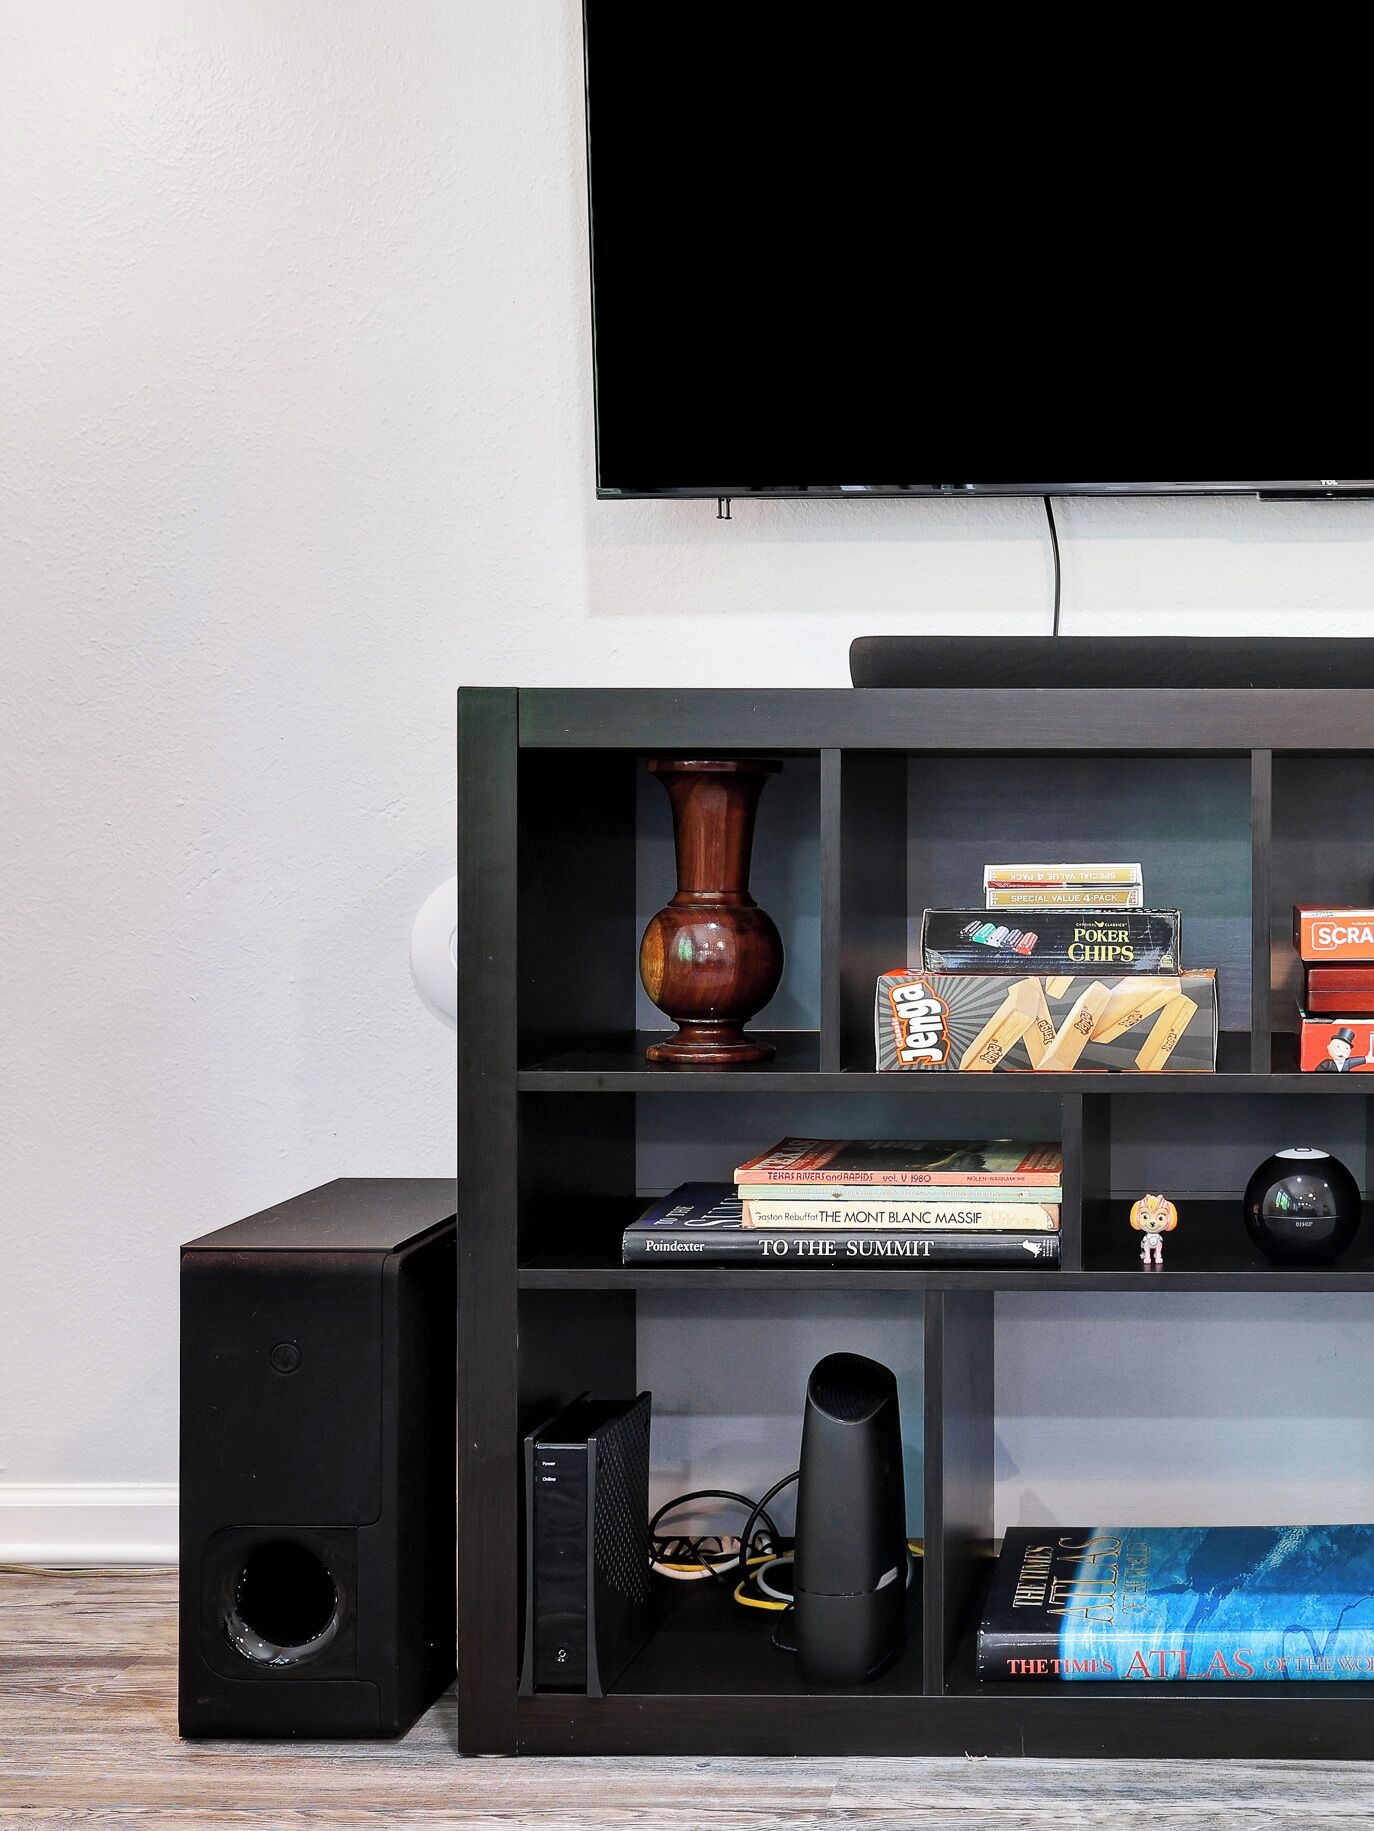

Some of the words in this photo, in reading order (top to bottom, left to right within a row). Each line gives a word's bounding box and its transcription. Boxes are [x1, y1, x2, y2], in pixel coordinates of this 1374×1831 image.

[1047, 872, 1076, 880] VALUE
[1081, 872, 1117, 880] SPECIAL
[1011, 894, 1049, 902] SPECIAL
[1051, 894, 1080, 902] VALUE
[1082, 894, 1118, 902] 4-PACK
[1074, 928, 1130, 942] POKER
[1068, 942, 1135, 962] CHIPS
[892, 983, 944, 1062] Jenga
[1036, 1019, 1054, 1045] Jenga
[1074, 1009, 1094, 1036] Jenga
[980, 1042, 1003, 1064] Jenga
[768, 1172, 794, 1180] TEXAS
[882, 1174, 898, 1182] vol.
[901, 1174, 907, 1182] V
[910, 1174, 932, 1183] 1980
[818, 1210, 841, 1222] THE
[844, 1211, 886, 1224] MONT
[888, 1212, 932, 1224] BLANC
[935, 1212, 982, 1224] MASSIF
[645, 1240, 705, 1252] Poindexter
[758, 1240, 788, 1256] TO
[793, 1240, 836, 1256] THE
[846, 1240, 934, 1257] SUMMIT
[1019, 1546, 1054, 1581] TIMES
[1046, 1536, 1122, 1626] ATLAS
[1012, 1582, 1046, 1608] THE
[1006, 1659, 1048, 1674] THE
[1050, 1658, 1114, 1674] TIMES
[1120, 1649, 1254, 1679] ATLAS
[1264, 1656, 1293, 1672] OF
[1292, 1656, 1336, 1672] THE
